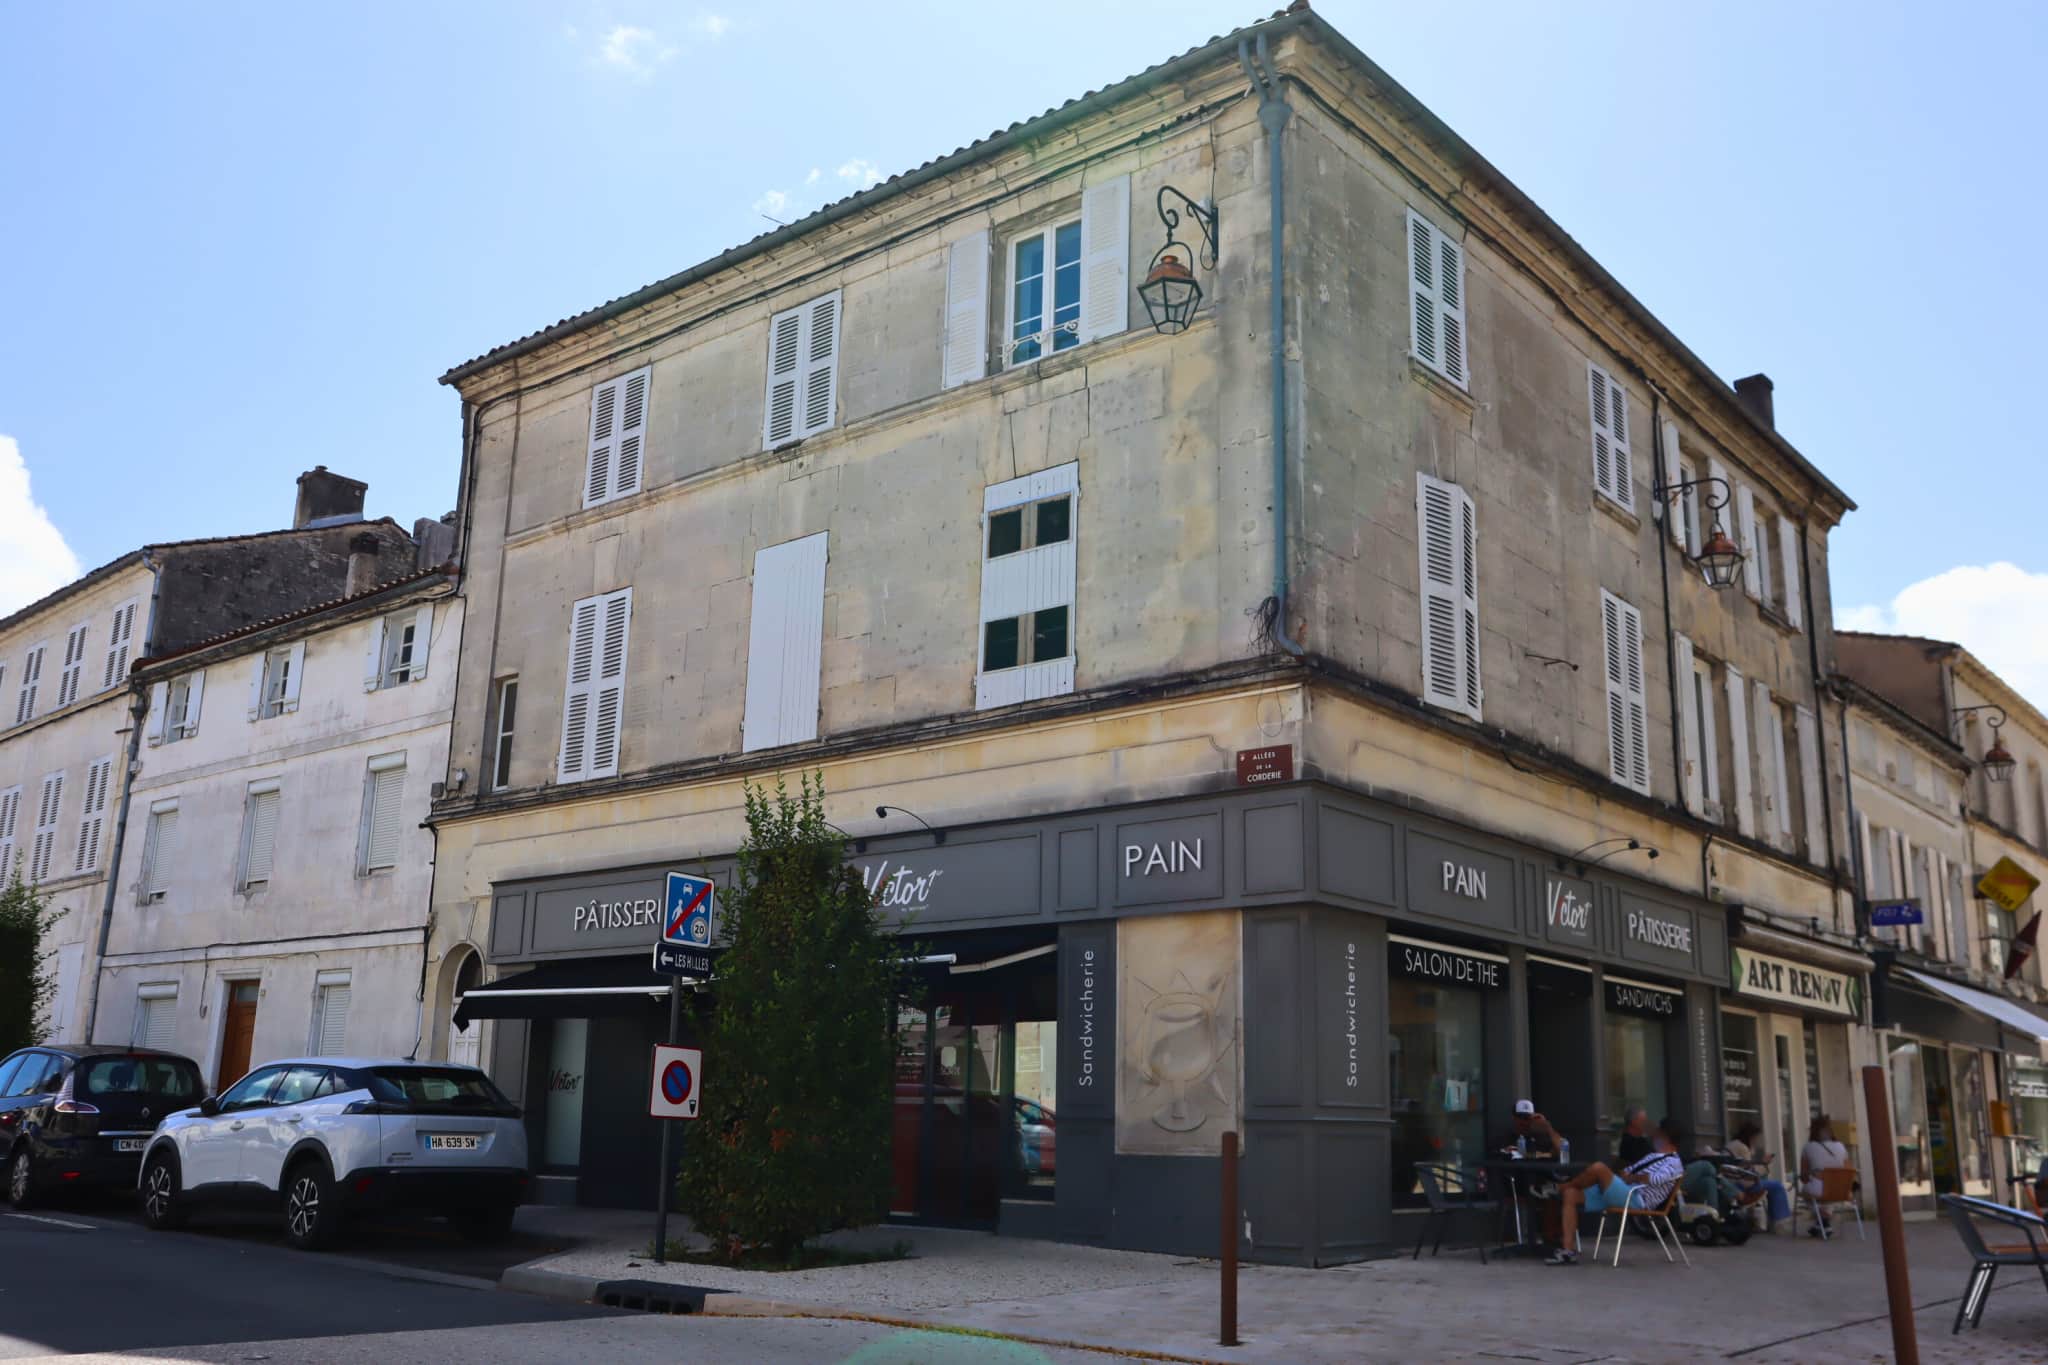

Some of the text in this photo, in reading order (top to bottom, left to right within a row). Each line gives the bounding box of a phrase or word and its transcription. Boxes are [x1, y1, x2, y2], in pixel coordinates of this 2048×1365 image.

[1247, 770, 1282, 782] CORDERIE
[1125, 838, 1202, 877] PAIN
[1442, 861, 1487, 901] PAIN
[574, 899, 662, 931] PÂTISSERI
[694, 925, 705, 935] 20
[1628, 909, 1692, 953] PÂTISSERIE
[674, 954, 687, 969] LES
[1405, 949, 1452, 977] SALON
[1456, 959, 1473, 982] DE
[1747, 958, 1784, 993] ART
[1345, 943, 1358, 1088] Sandwicherie
[1616, 985, 1673, 1015] SANDWICHS
[1079, 950, 1095, 1087] Sandwicherie
